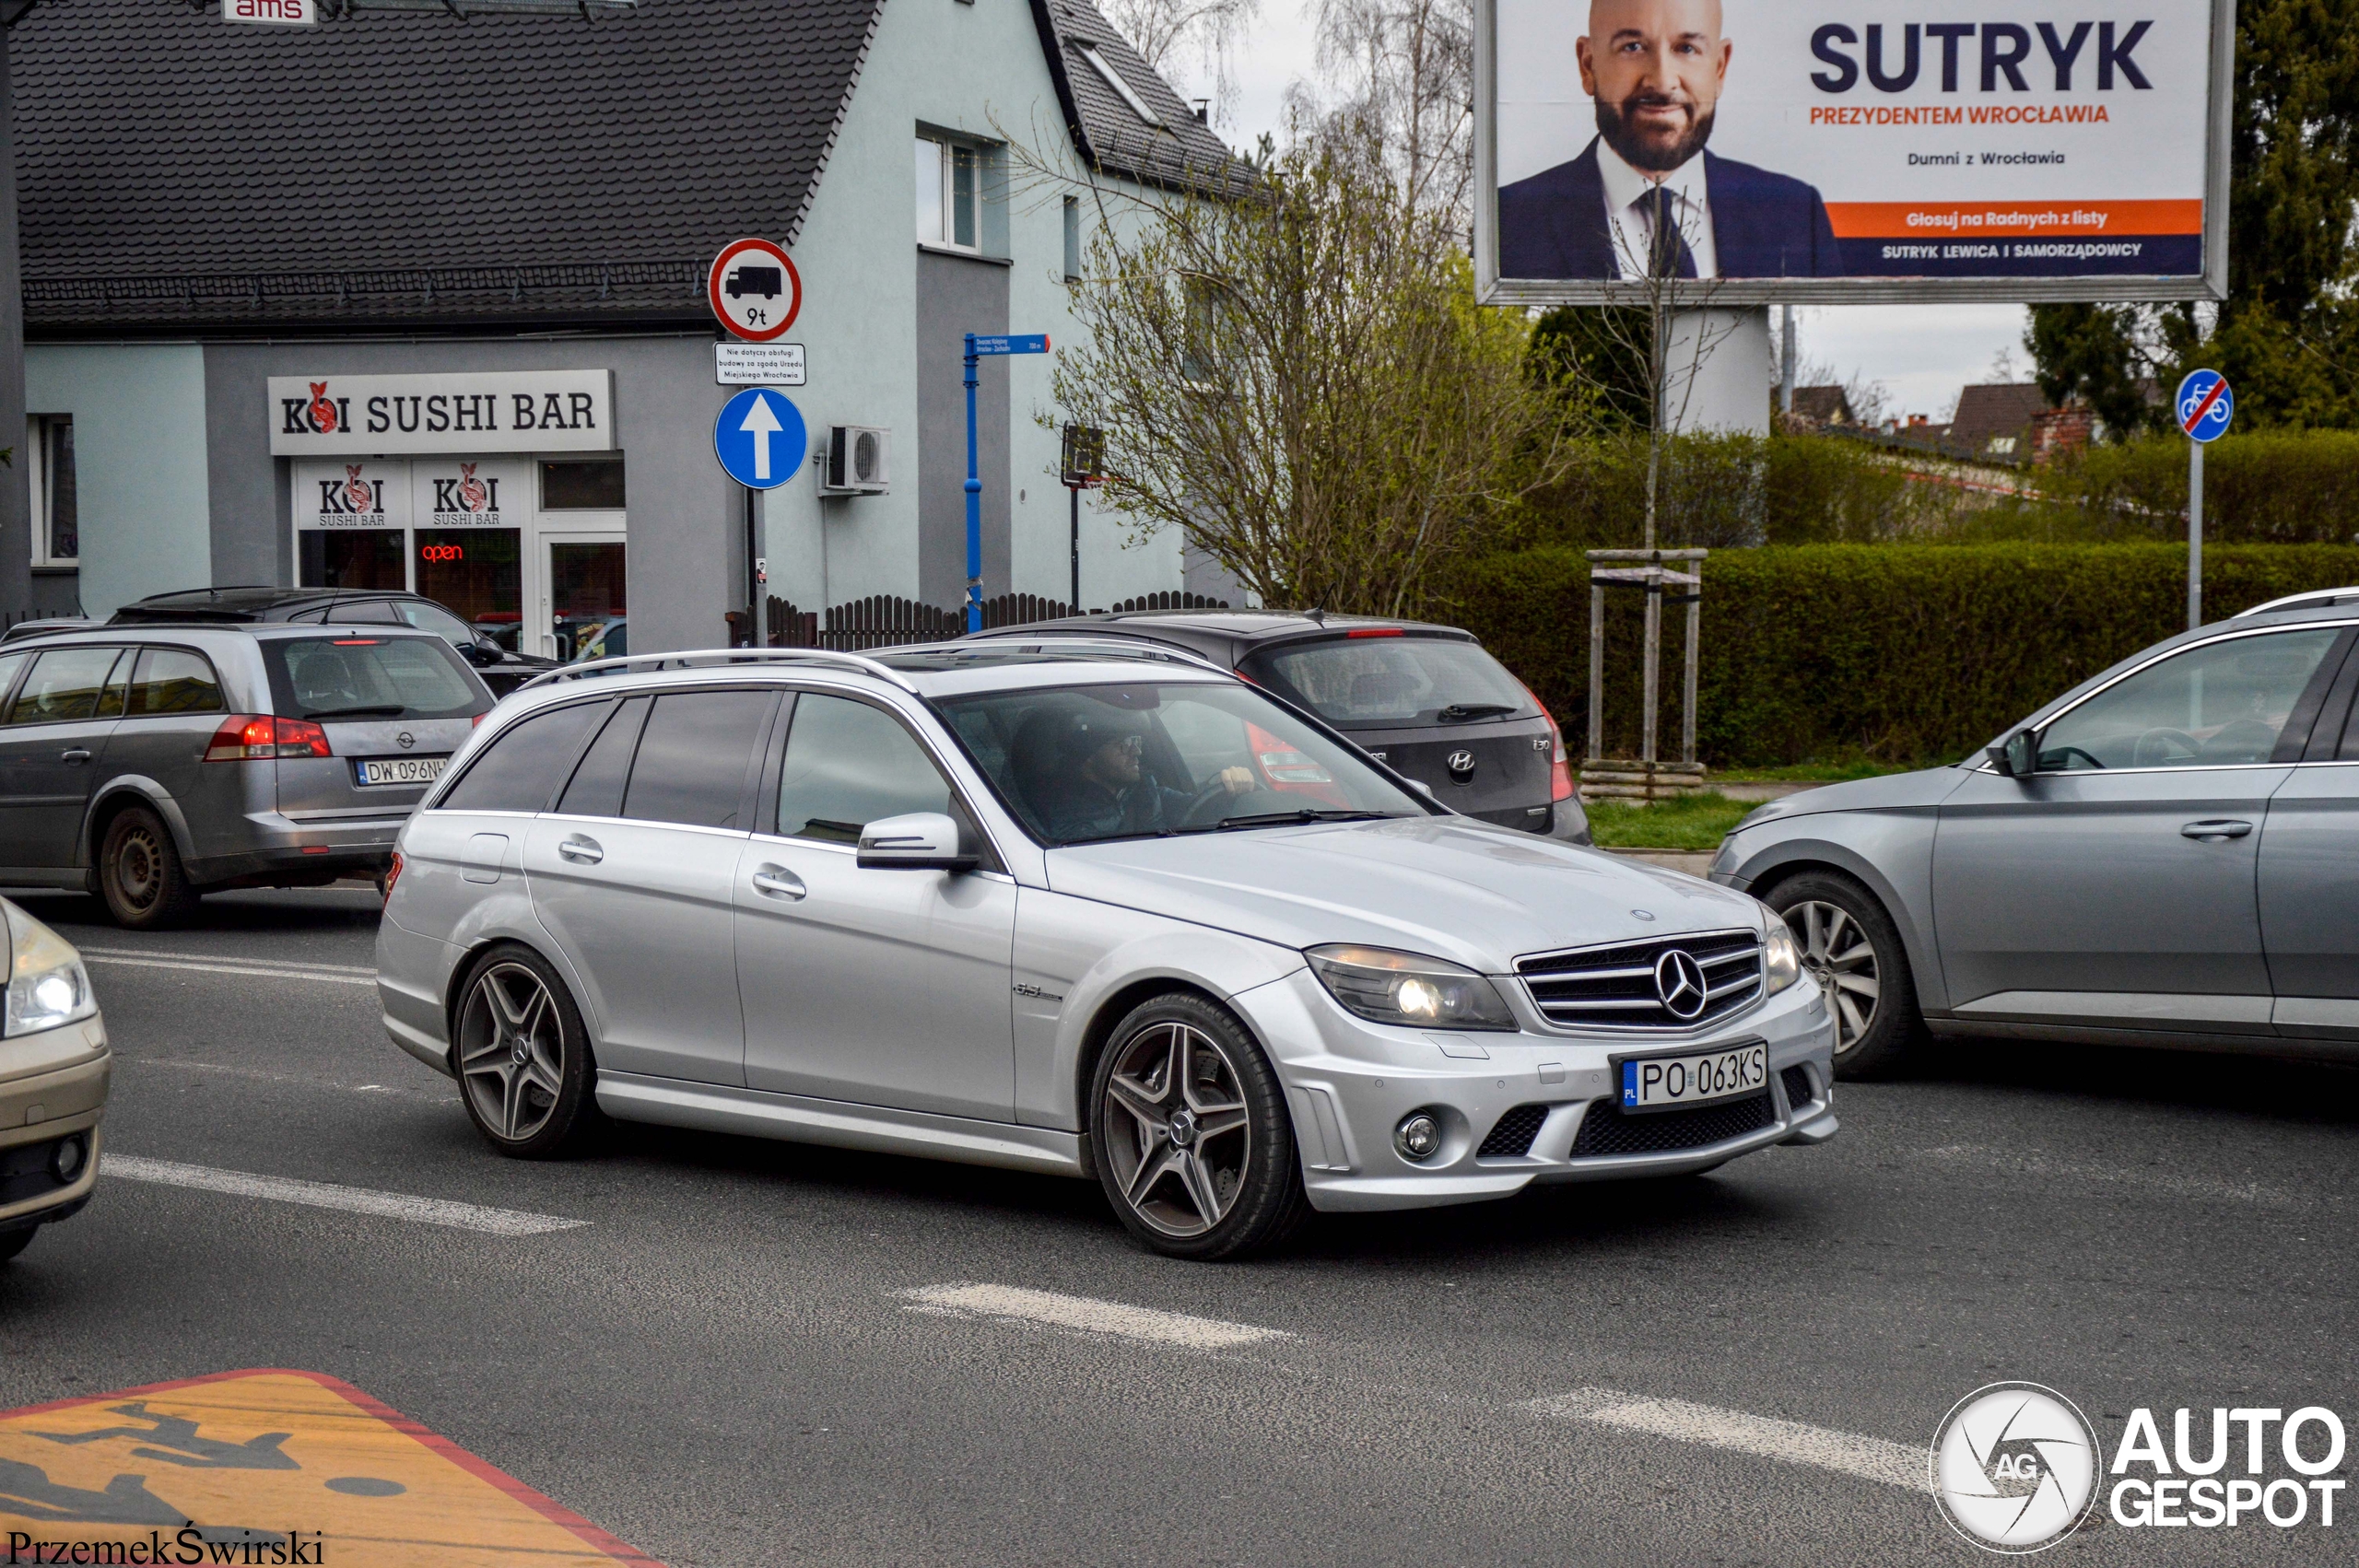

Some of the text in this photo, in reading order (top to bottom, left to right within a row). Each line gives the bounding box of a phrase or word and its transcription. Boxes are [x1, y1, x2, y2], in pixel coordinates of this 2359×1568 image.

[236, 0, 302, 18] ams
[1810, 20, 2155, 93] SUTRYK
[1810, 104, 2109, 125] PREZYDENTEM WROCŁAWIA
[1907, 151, 2065, 166] Dumni z Wrocławia
[1906, 210, 2108, 230] Głosuj na Radnych z listy
[1882, 243, 2142, 260] SUTRYK LEWICA I SAMORZĄDOWCY
[741, 349, 766, 357] dotyczy
[769, 349, 794, 358] obsługi
[724, 371, 761, 380] Miejskiego
[281, 392, 596, 434] KOI SUSHI BAR
[319, 479, 384, 514] KOI
[433, 477, 499, 513] KOI
[320, 515, 385, 526] SUSHI BAR
[433, 514, 499, 525] SUSHI BAR
[422, 545, 464, 563] open
[1532, 740, 1550, 751] i30
[369, 763, 393, 781] DW
[1643, 1048, 1763, 1101] PO 063KS
[1625, 1089, 1636, 1099] PL
